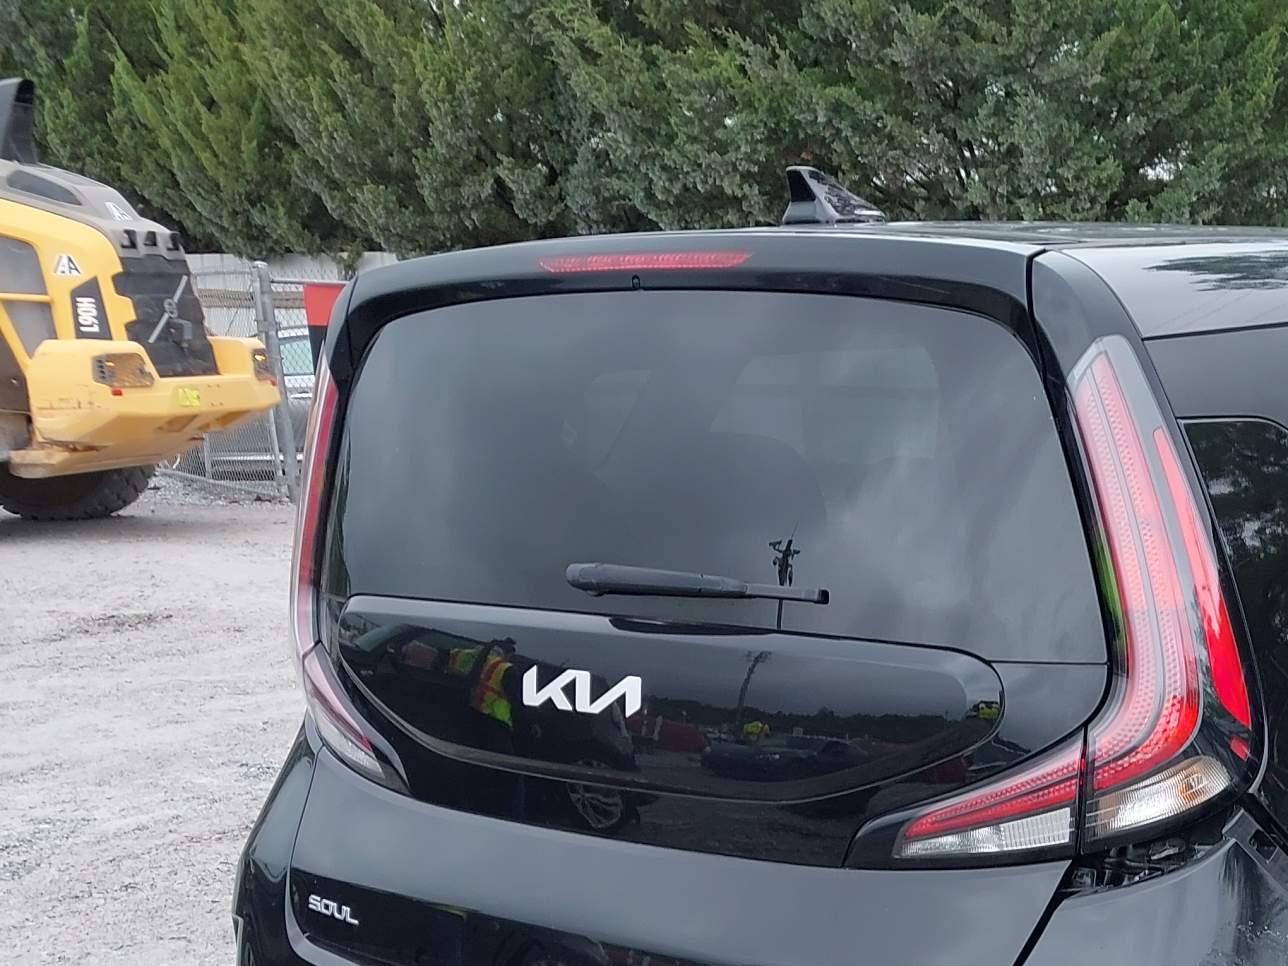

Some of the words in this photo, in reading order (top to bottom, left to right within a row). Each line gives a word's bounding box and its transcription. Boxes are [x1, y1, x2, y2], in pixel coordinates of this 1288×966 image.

[75, 296, 100, 333] L90H
[522, 664, 642, 718] KIA
[308, 893, 359, 926] SOUL
